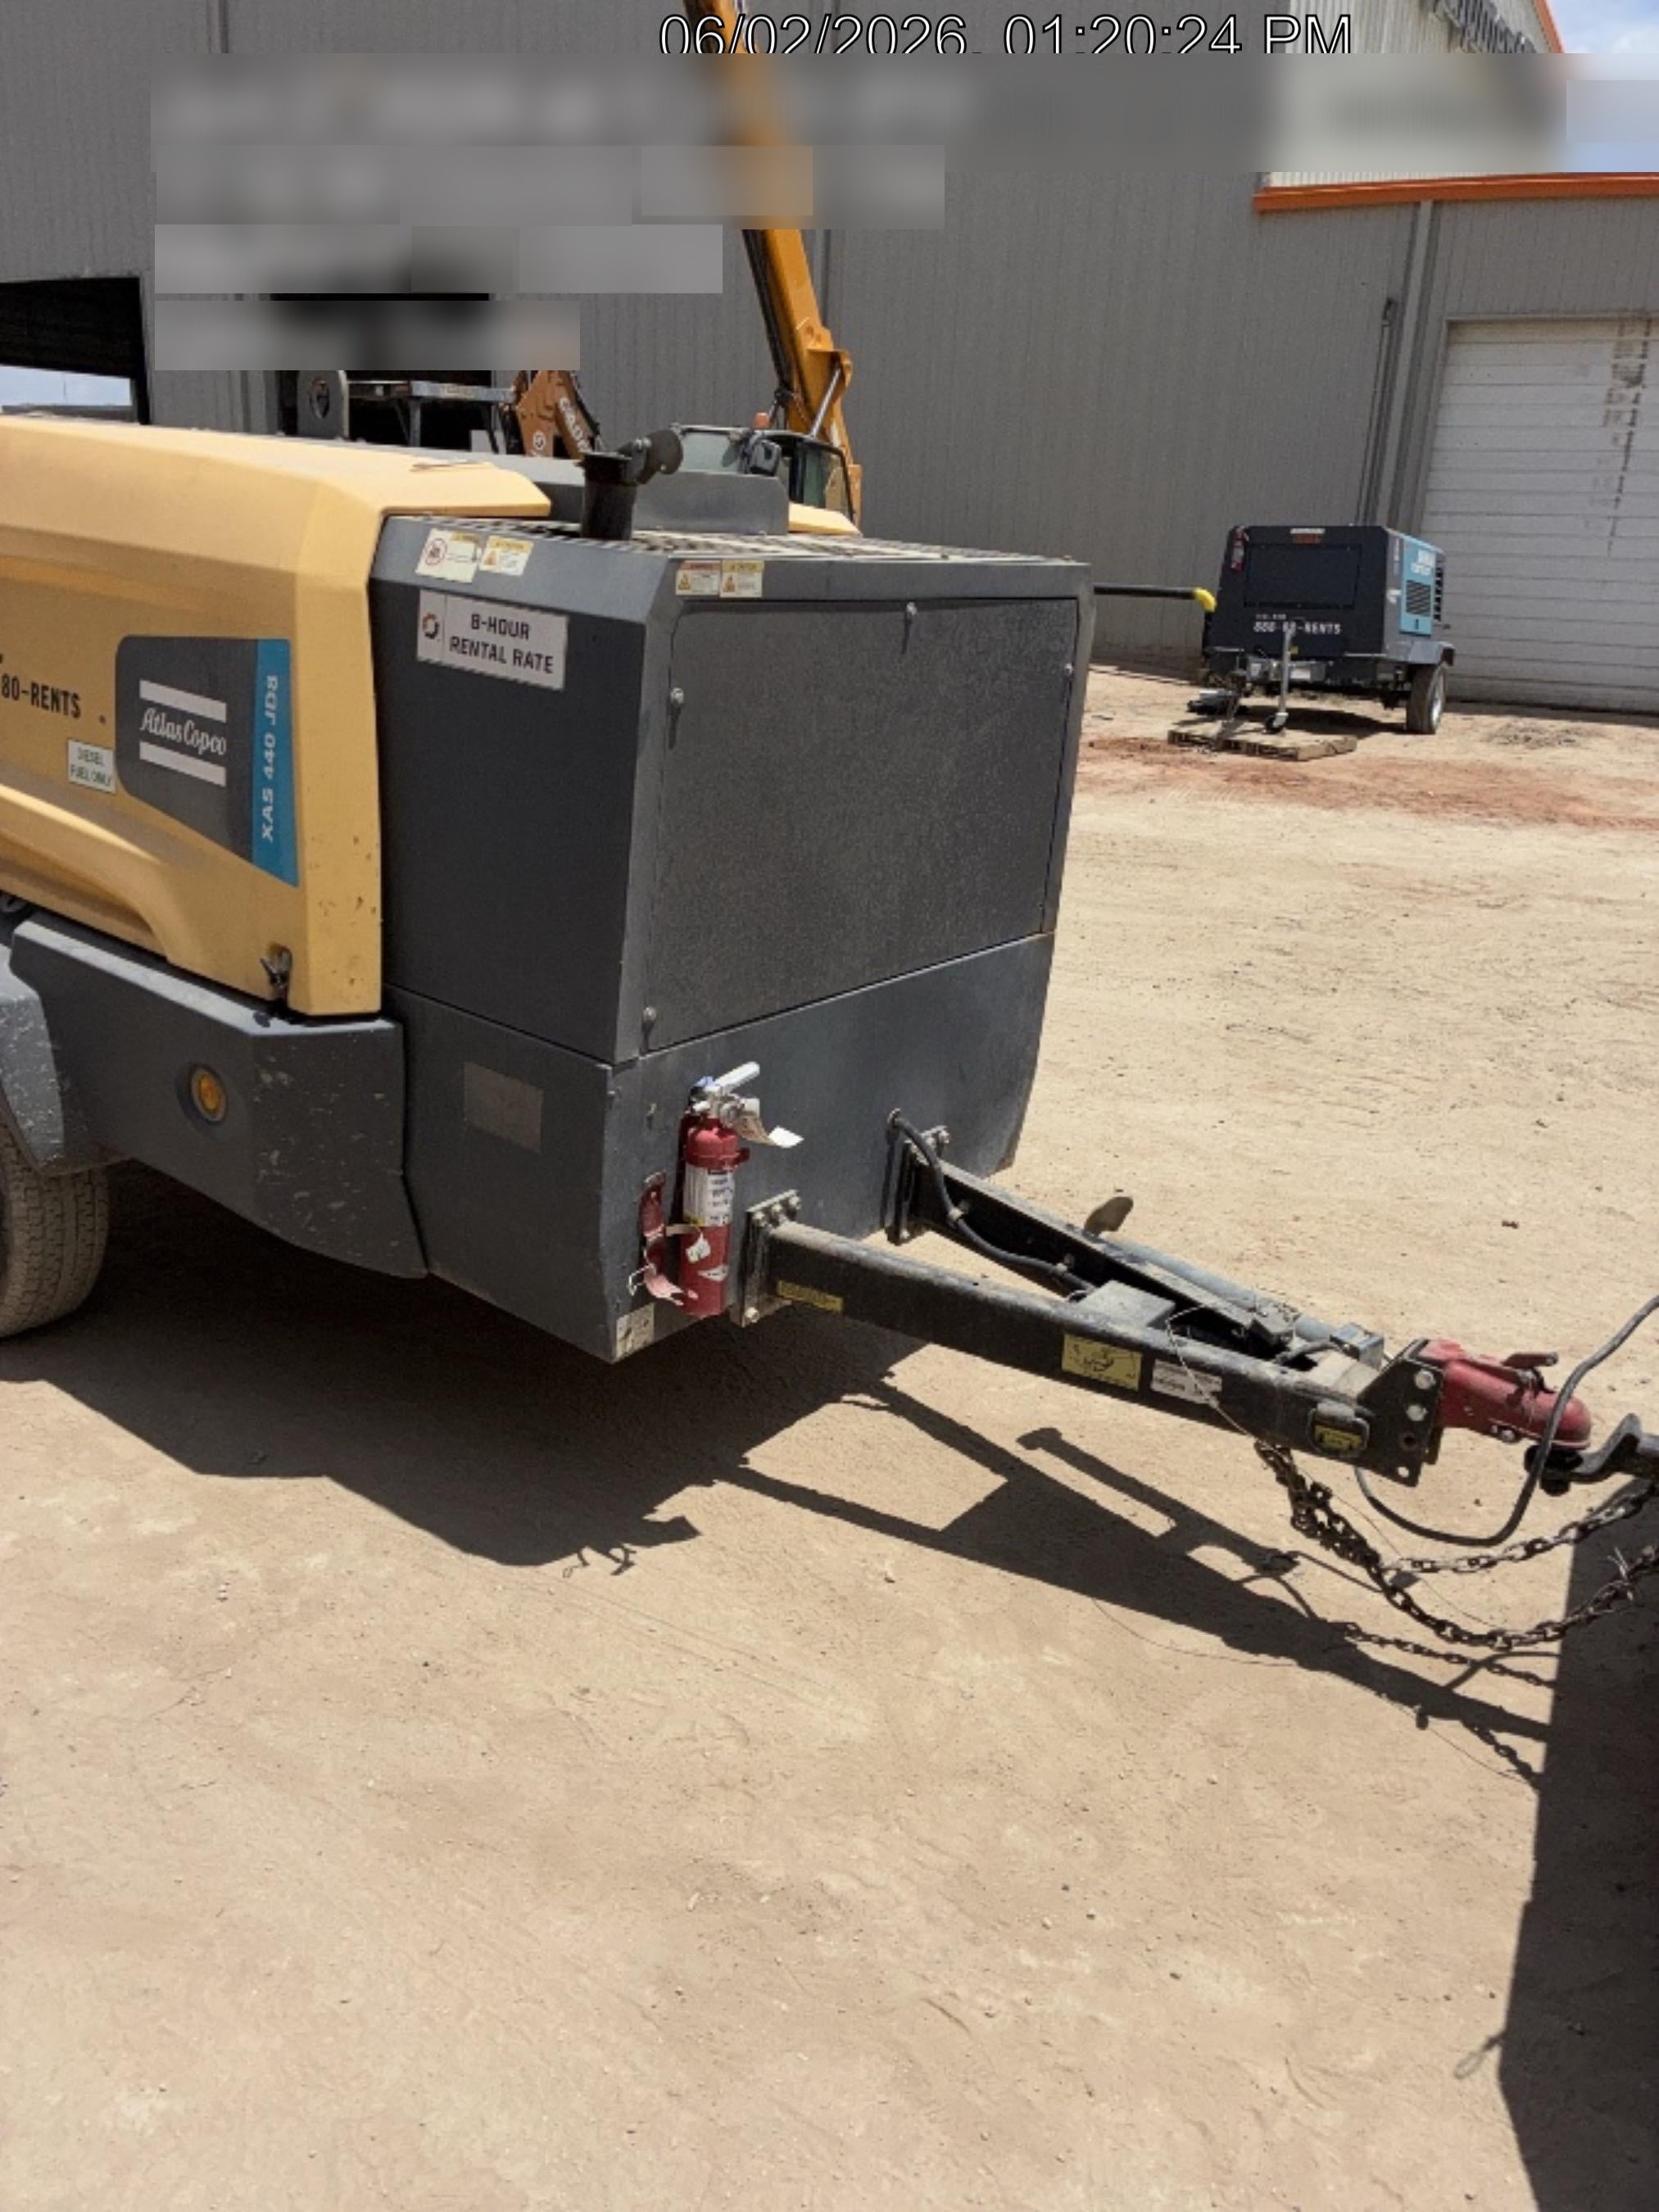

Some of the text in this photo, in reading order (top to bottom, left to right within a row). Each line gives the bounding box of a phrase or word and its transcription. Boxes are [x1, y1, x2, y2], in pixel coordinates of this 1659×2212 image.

[471, 614, 530, 641] 8-HOUR
[450, 636, 553, 674] RENTAL RATE
[1, 673, 81, 718] 80-RENTS
[263, 732, 276, 780] 440
[262, 788, 274, 844] XAS
